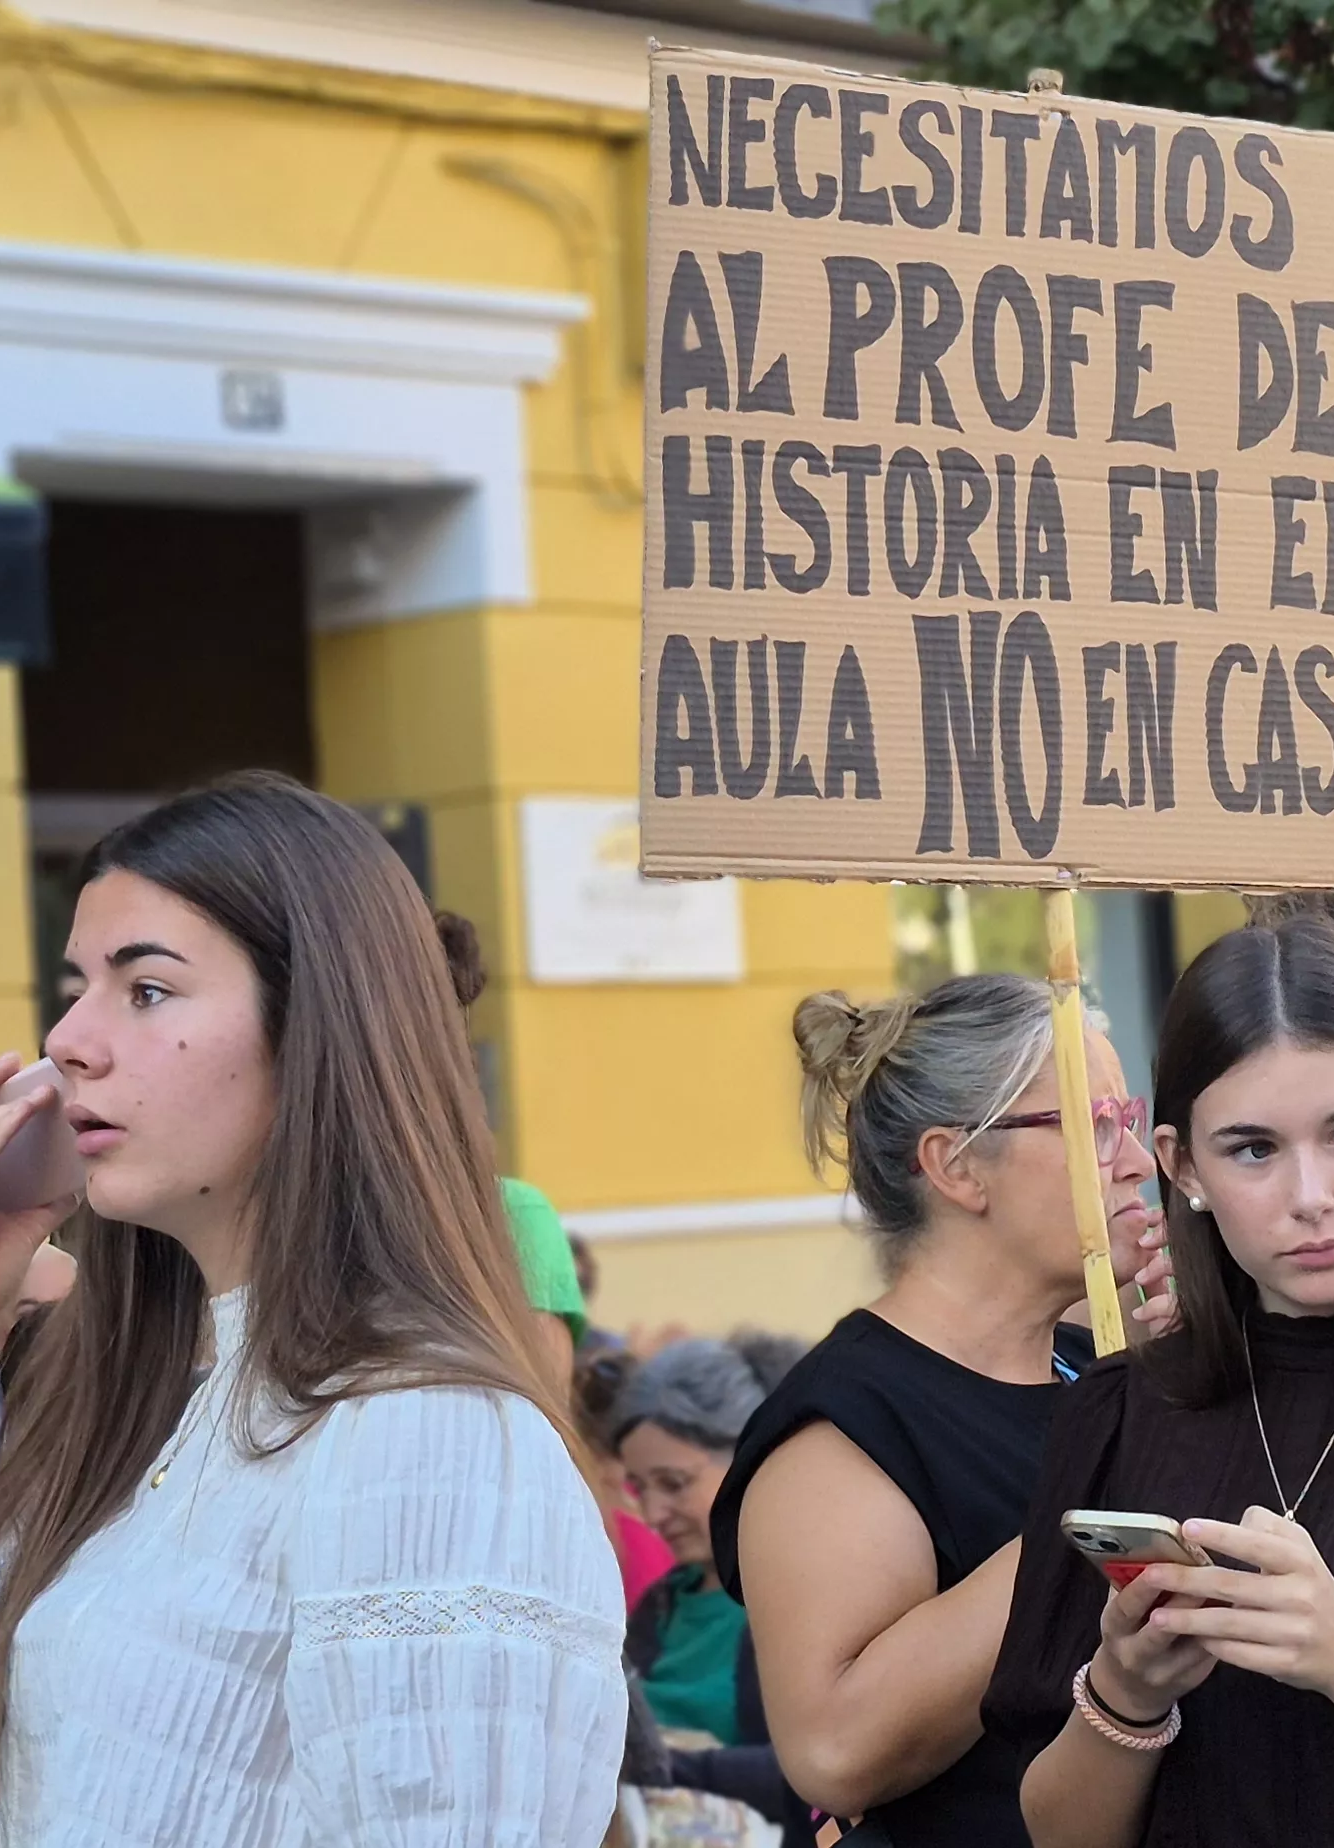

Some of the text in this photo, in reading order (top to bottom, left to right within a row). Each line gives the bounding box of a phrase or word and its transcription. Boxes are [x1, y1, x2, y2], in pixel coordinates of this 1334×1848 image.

[666, 74, 1294, 271] NECESITAMOS
[660, 250, 796, 416] AL
[822, 256, 1177, 452] PROFE
[661, 434, 1072, 605] HISTORIA
[1108, 465, 1219, 612] EN
[653, 634, 882, 801] AULA
[911, 609, 1063, 860] NO
[1081, 641, 1178, 813] EN
